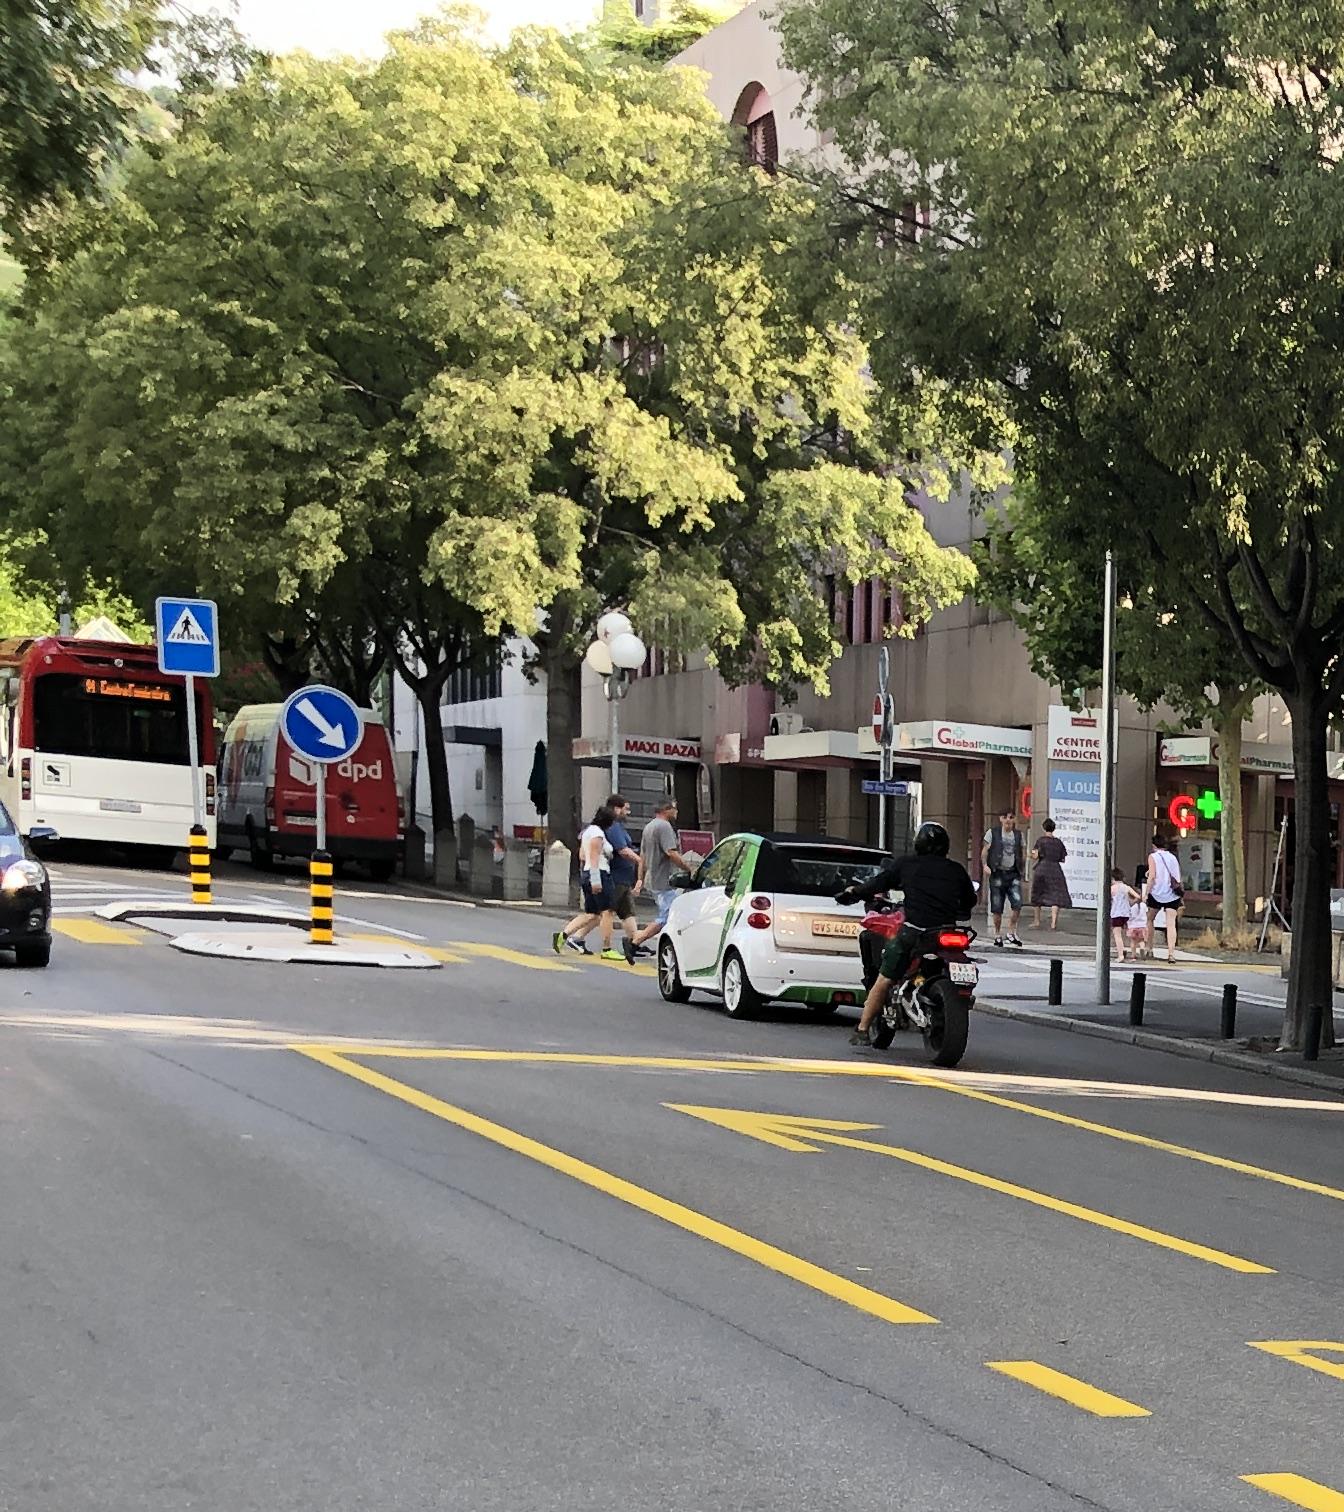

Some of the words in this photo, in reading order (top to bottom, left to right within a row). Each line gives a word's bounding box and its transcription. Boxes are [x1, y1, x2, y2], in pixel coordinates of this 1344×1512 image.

[625, 739, 660, 752] MAXI
[664, 743, 701, 759] BAZA
[1056, 737, 1100, 748] CENTRE
[337, 758, 383, 783] dpd
[1067, 781, 1101, 795] LOUE
